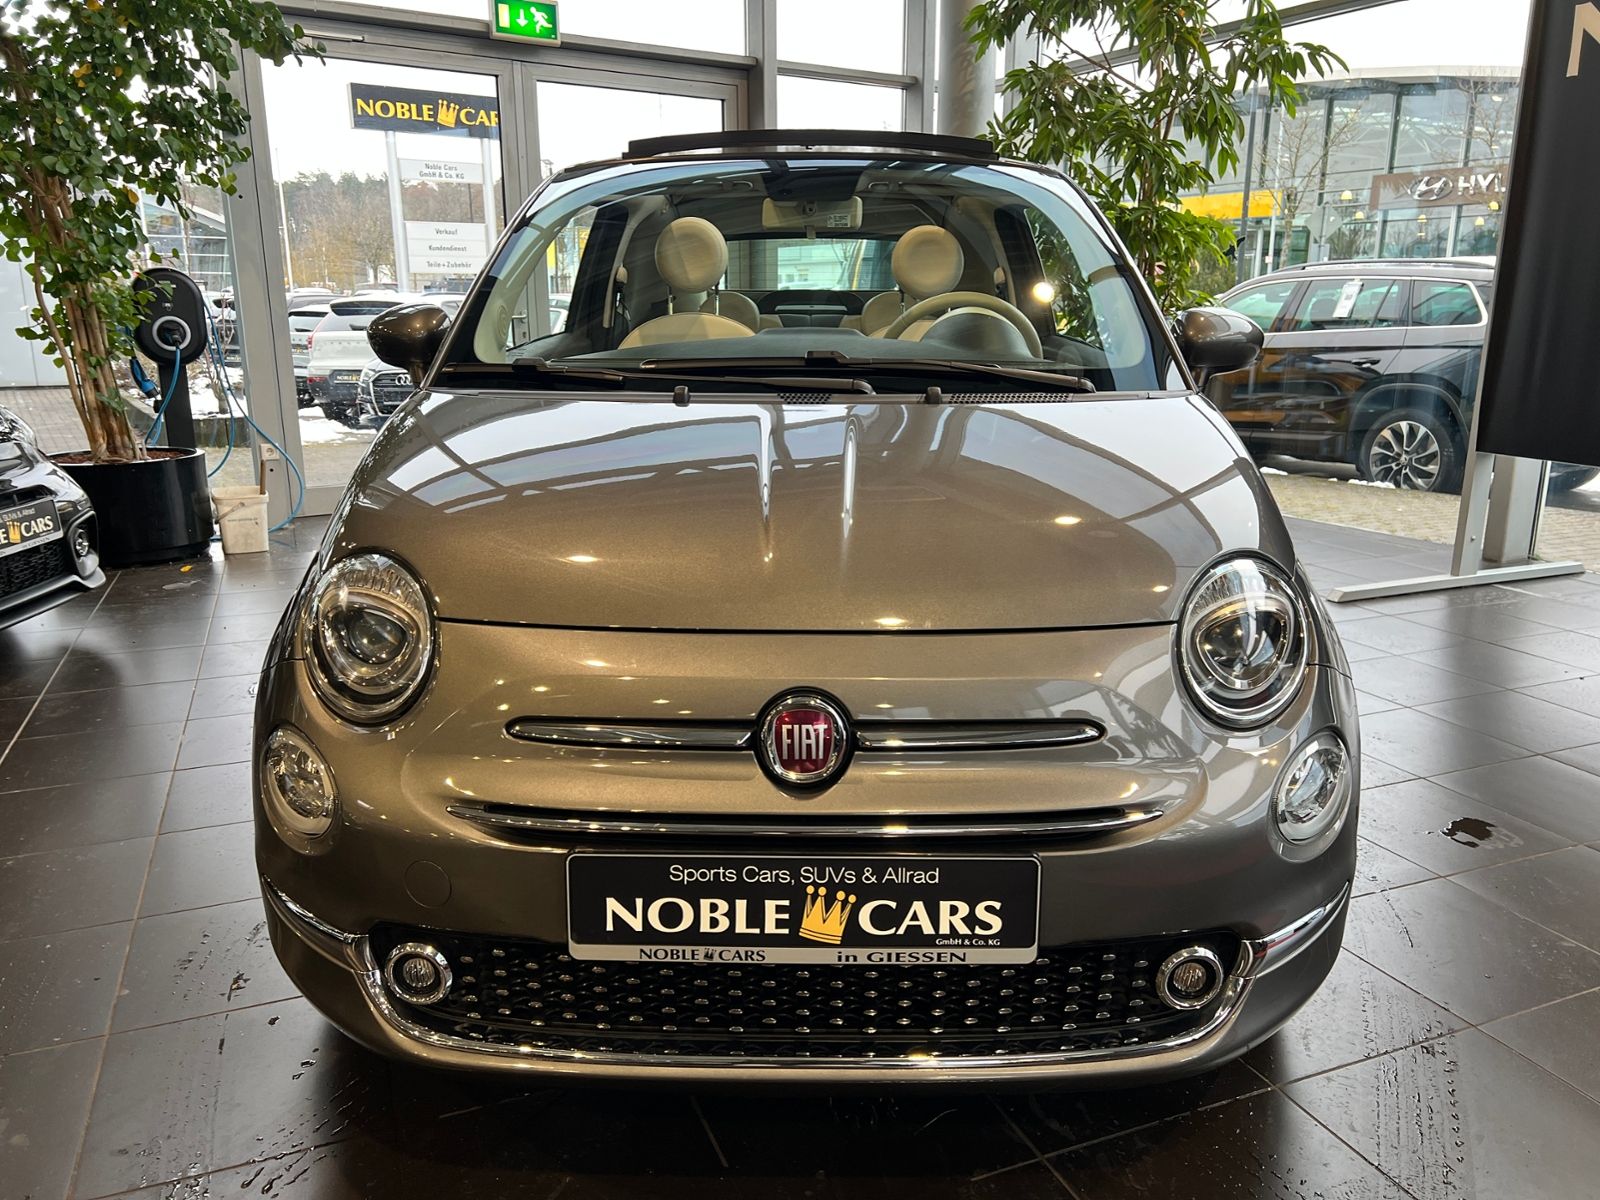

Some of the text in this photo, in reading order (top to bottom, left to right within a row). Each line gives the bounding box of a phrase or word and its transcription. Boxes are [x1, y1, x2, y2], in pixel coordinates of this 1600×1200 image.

[356, 98, 434, 122] NOBLE
[419, 170, 437, 178] GmbH
[21, 516, 53, 537] CARS
[781, 724, 828, 760] FIAT
[669, 864, 939, 885] Sports Cars, SUVs & Allrad
[605, 897, 1003, 936] NOBLE CARS
[935, 938, 1001, 946] GmbH & Co. KG
[639, 948, 767, 962] NOBLE CARS
[837, 951, 967, 963] in GIESSEN
